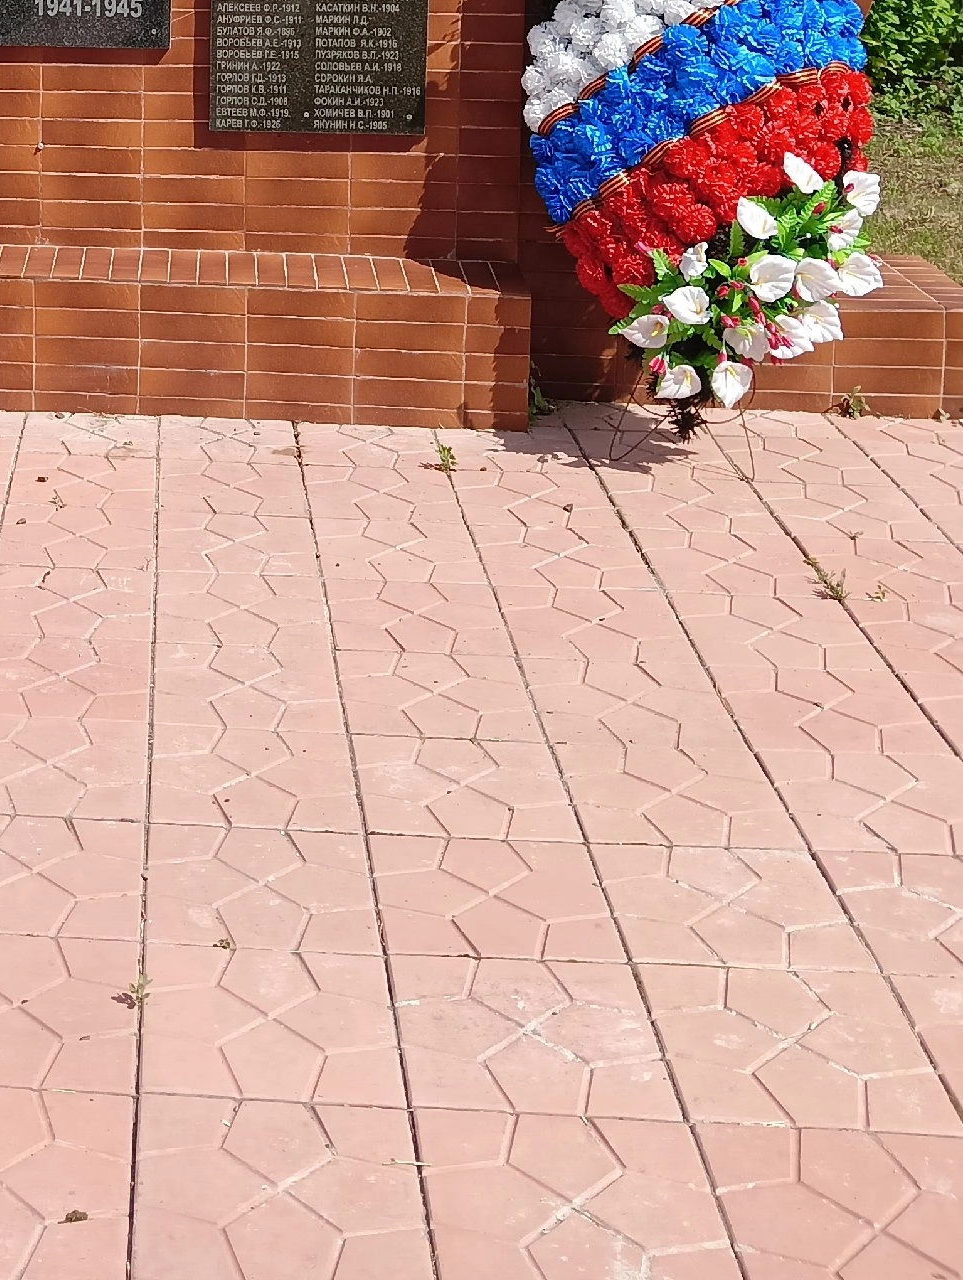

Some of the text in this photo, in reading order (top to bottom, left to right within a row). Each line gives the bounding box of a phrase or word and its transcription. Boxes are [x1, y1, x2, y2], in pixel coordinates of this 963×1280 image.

[217, 3, 260, 12] АЛЕКСЕЕВ
[316, 4, 360, 12] КАСАТКИН
[217, 15, 262, 24] АНУФРИЕВ
[316, 15, 350, 24] МАРКИН
[217, 27, 255, 35] БУЛАТОВ
[316, 27, 350, 35] МАРКИН
[217, 38, 262, 46] ВОРОБЬЕВ
[316, 39, 356, 47] ПОТАПОВ
[217, 50, 262, 58] ВОРОБЬЕВ
[316, 50, 359, 59] ПУЗРЯКОВ
[217, 61, 249, 70] ГРИНИН
[315, 62, 361, 70] СОЛОВЬЕВ
[217, 73, 249, 82] ГОРЛОВ
[315, 74, 355, 82] СОРОКИН
[217, 85, 249, 93] ГОРЛОВ
[314, 85, 381, 94] ТАРАКАНЧИКОВ
[217, 97, 249, 105] ГОРЛОВ
[314, 97, 344, 105] ФОКИН
[216, 108, 248, 116] ЕВТЕЕВ
[314, 109, 355, 117] ХОМИЧЕВ
[216, 119, 242, 127] КАРЕВ
[314, 120, 347, 129] ЯКУНИН
